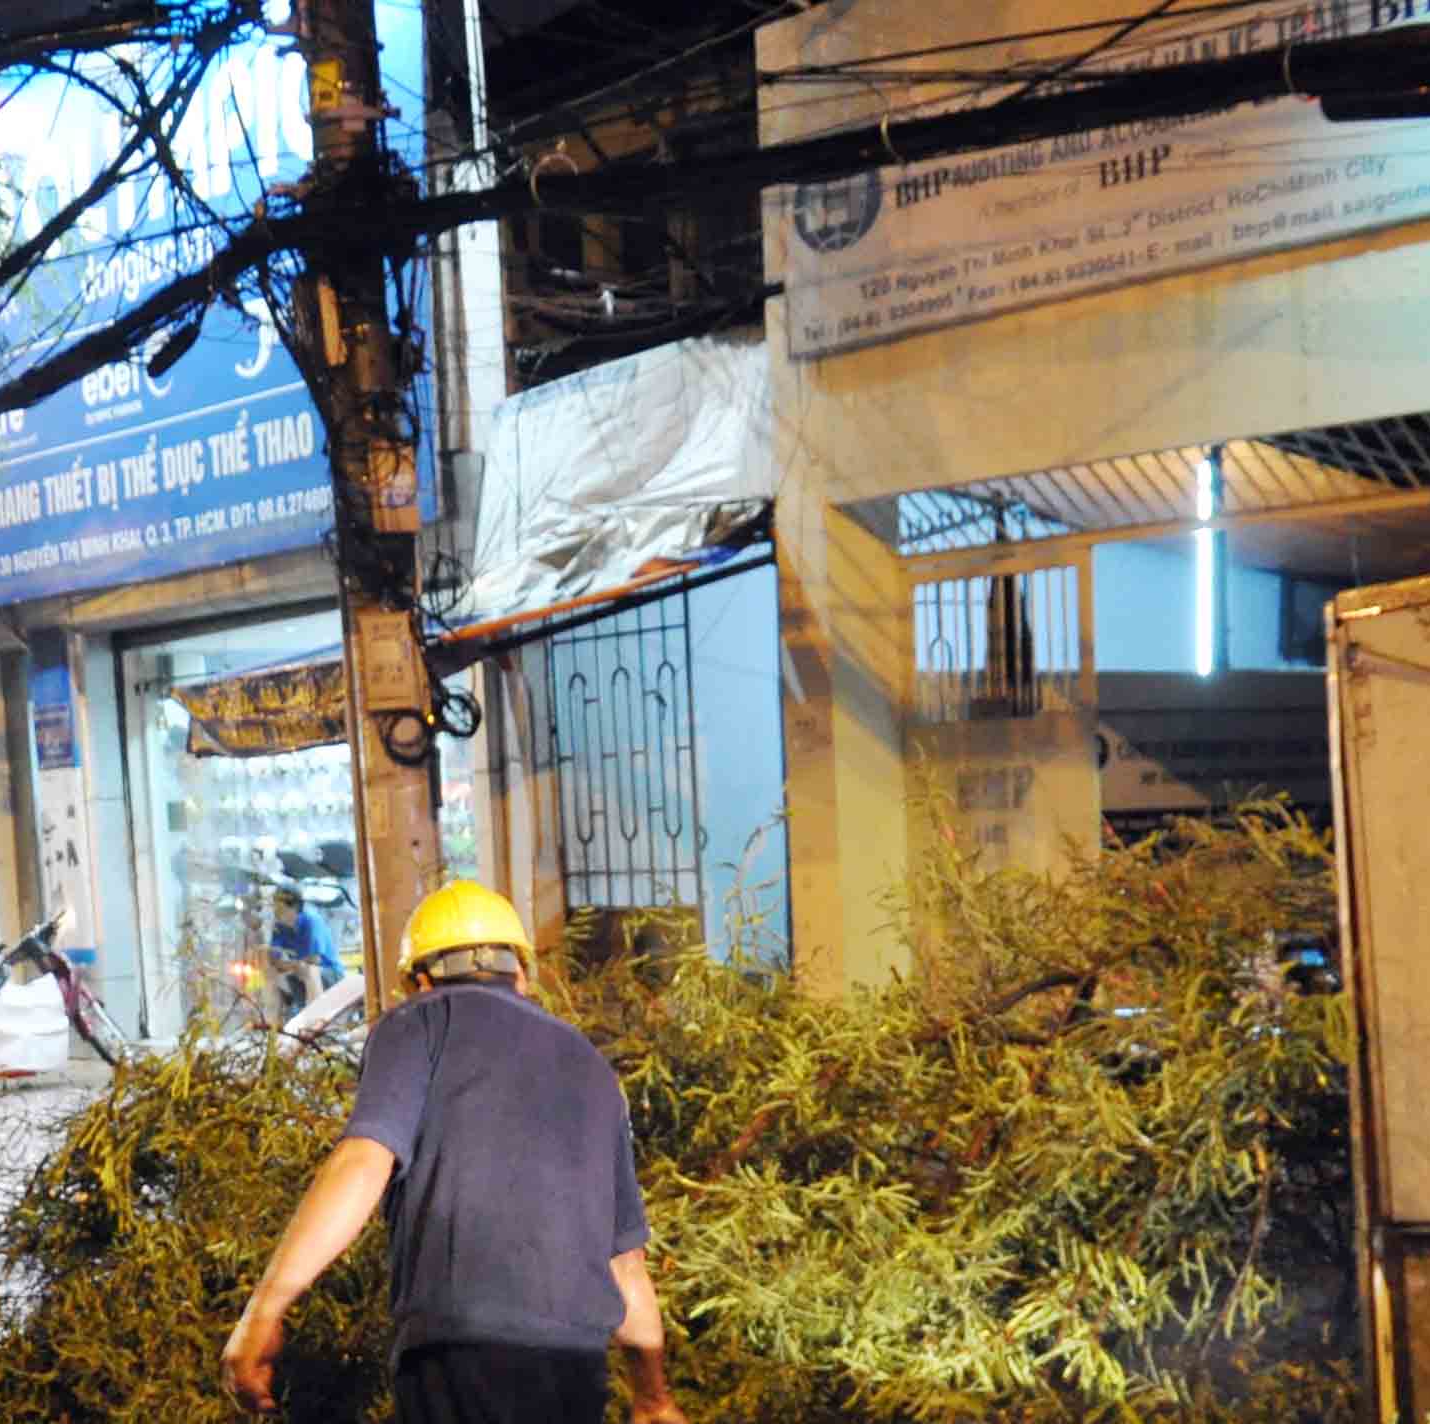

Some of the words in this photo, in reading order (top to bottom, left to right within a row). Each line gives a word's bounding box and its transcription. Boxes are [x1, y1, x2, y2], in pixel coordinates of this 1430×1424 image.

[1098, 145, 1172, 189] BHP
[96, 460, 120, 511] BỊ
[161, 441, 206, 496] DỤC
[253, 410, 316, 468] THAO
